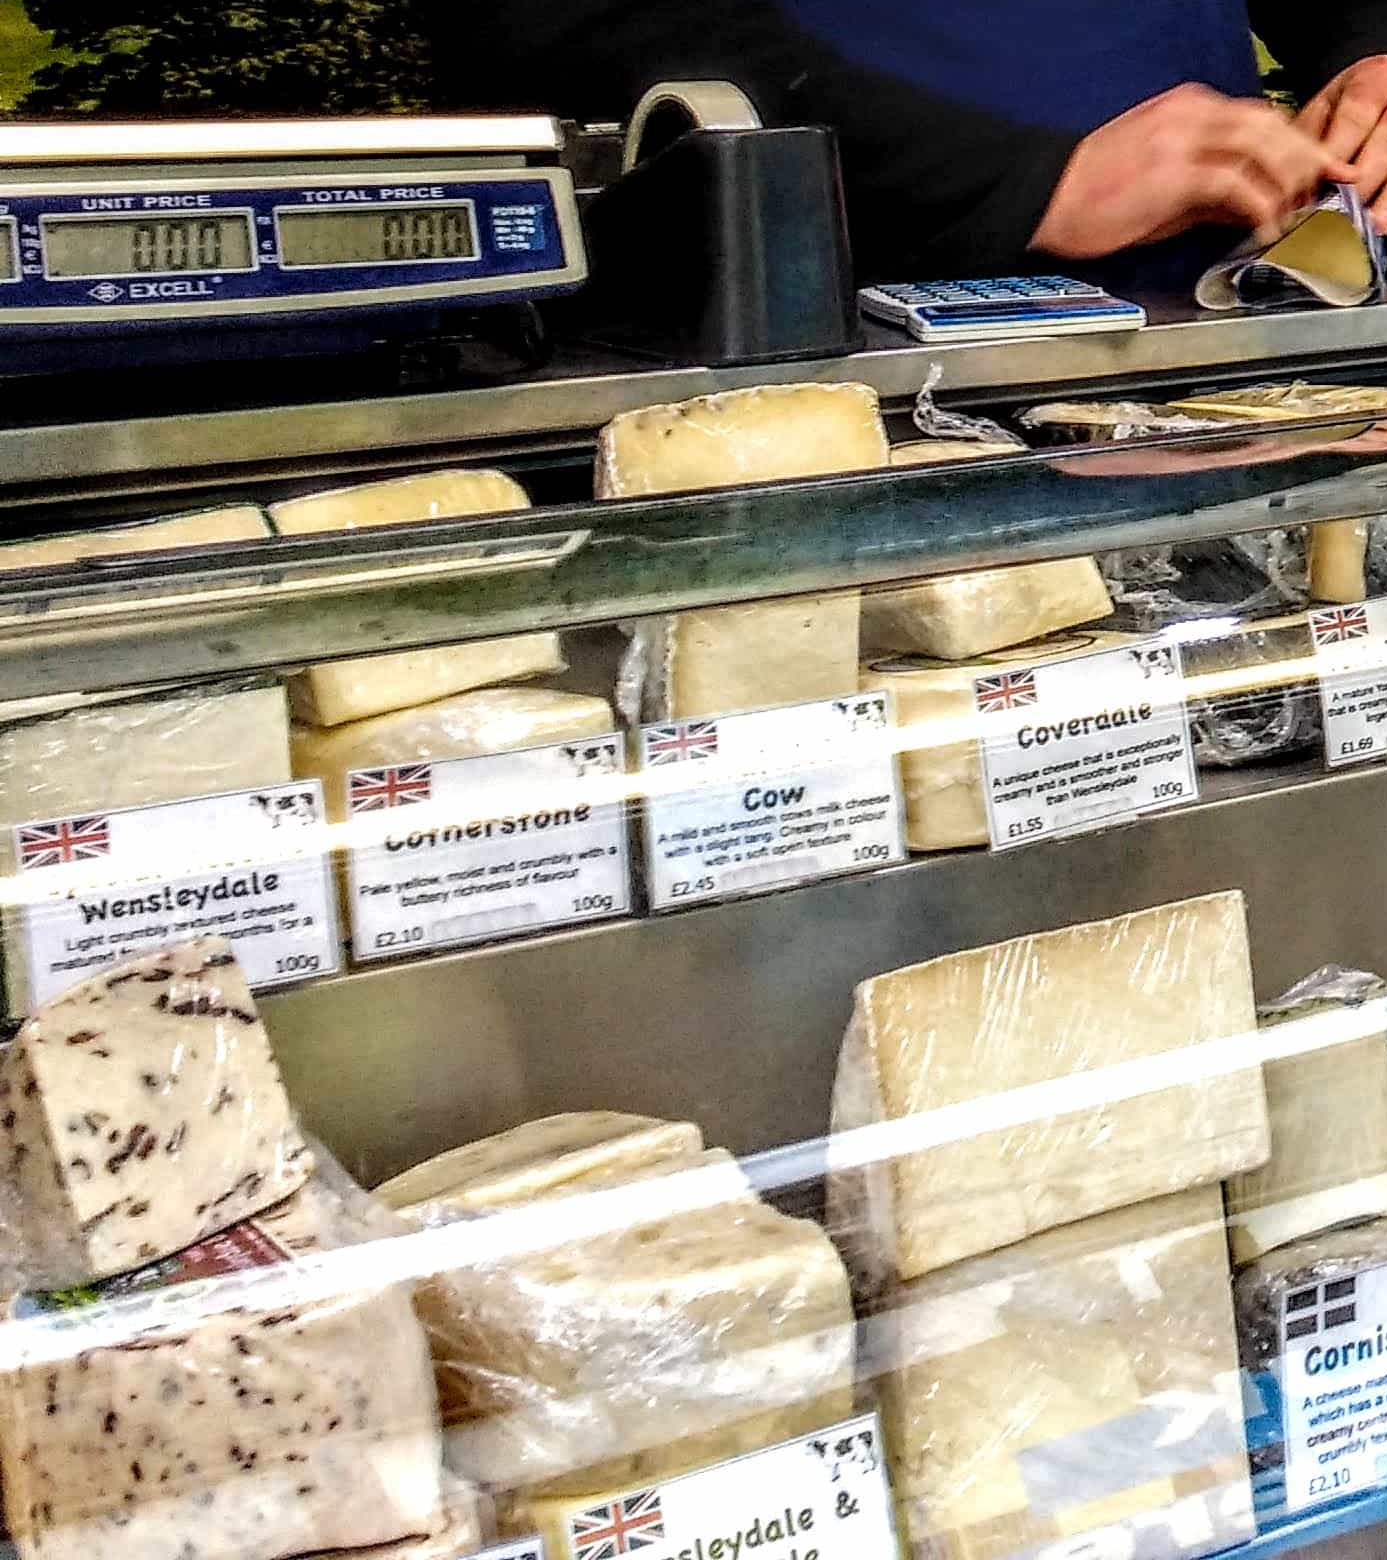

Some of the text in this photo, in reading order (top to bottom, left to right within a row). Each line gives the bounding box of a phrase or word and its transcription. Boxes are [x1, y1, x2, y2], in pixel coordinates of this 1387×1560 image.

[81, 186, 446, 211] UNIT PRICE TOTAL PRICE
[129, 281, 215, 299] EXCELL
[742, 786, 806, 812] Cow
[1008, 781, 1183, 838] £1.55 100g
[669, 844, 890, 898] £2.45 100g
[79, 872, 279, 925] Wensleydale
[373, 894, 616, 949] £2.10 100g
[275, 954, 324, 975] 100g
[1308, 1467, 1351, 1496] £2.10
[835, 1490, 860, 1519] &
